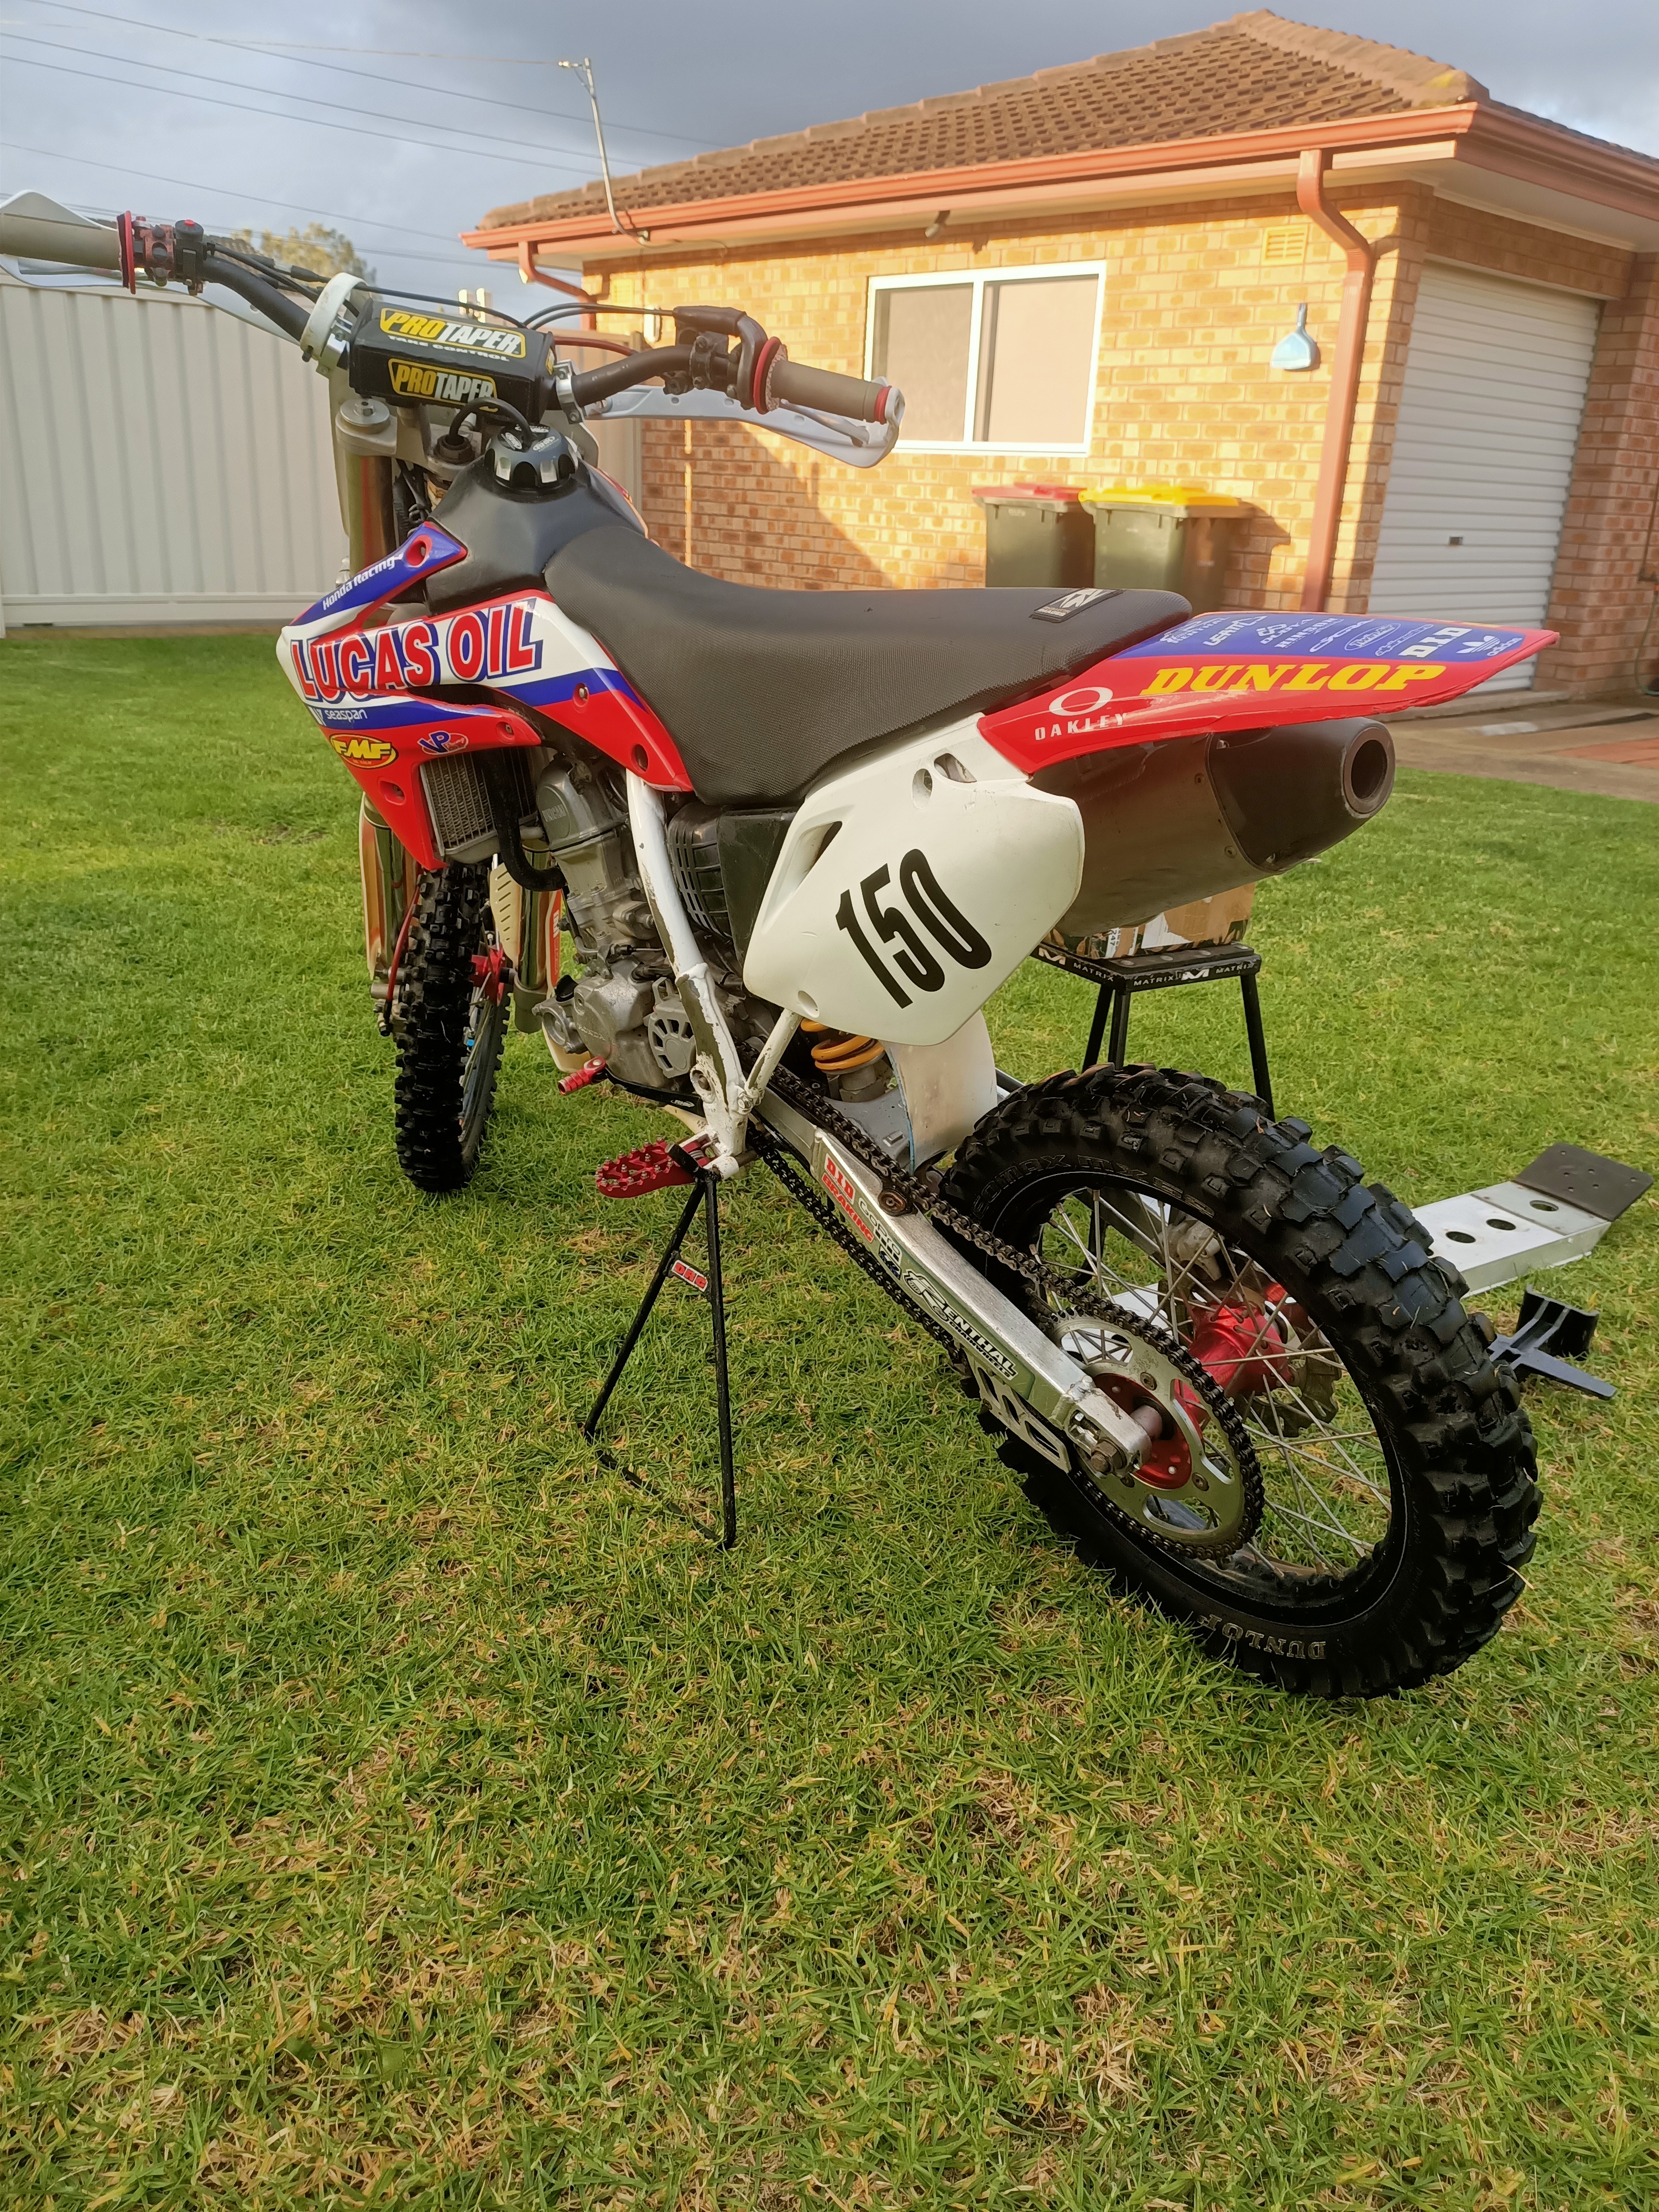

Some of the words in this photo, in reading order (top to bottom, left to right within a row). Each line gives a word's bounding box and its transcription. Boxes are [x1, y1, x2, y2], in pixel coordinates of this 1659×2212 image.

[382, 312, 521, 354] PROTAPER
[388, 335, 428, 347] TAKE
[432, 344, 509, 362] CONTROL
[323, 581, 353, 611] Honda
[353, 556, 399, 586] Racing
[1274, 618, 1339, 648] HINSON
[1486, 638, 1522, 656] adidas
[290, 620, 441, 705] LUCAS
[447, 598, 543, 682] OIL
[1139, 664, 1447, 696] DUNLOP
[324, 709, 368, 723] seaspan
[1035, 712, 1128, 740] OAKLEY
[332, 739, 391, 759] FMF
[419, 731, 450, 753] VP
[836, 848, 992, 1009] 150
[1073, 963, 1114, 982] MATRIX
[1133, 975, 1173, 987] MATRIX
[1215, 962, 1253, 974] MATRIX
[822, 1174, 874, 1243] BRAKING
[950, 1321, 1011, 1378] CHAINWHEELS
[1197, 1614, 1327, 1660] DUNLOP
